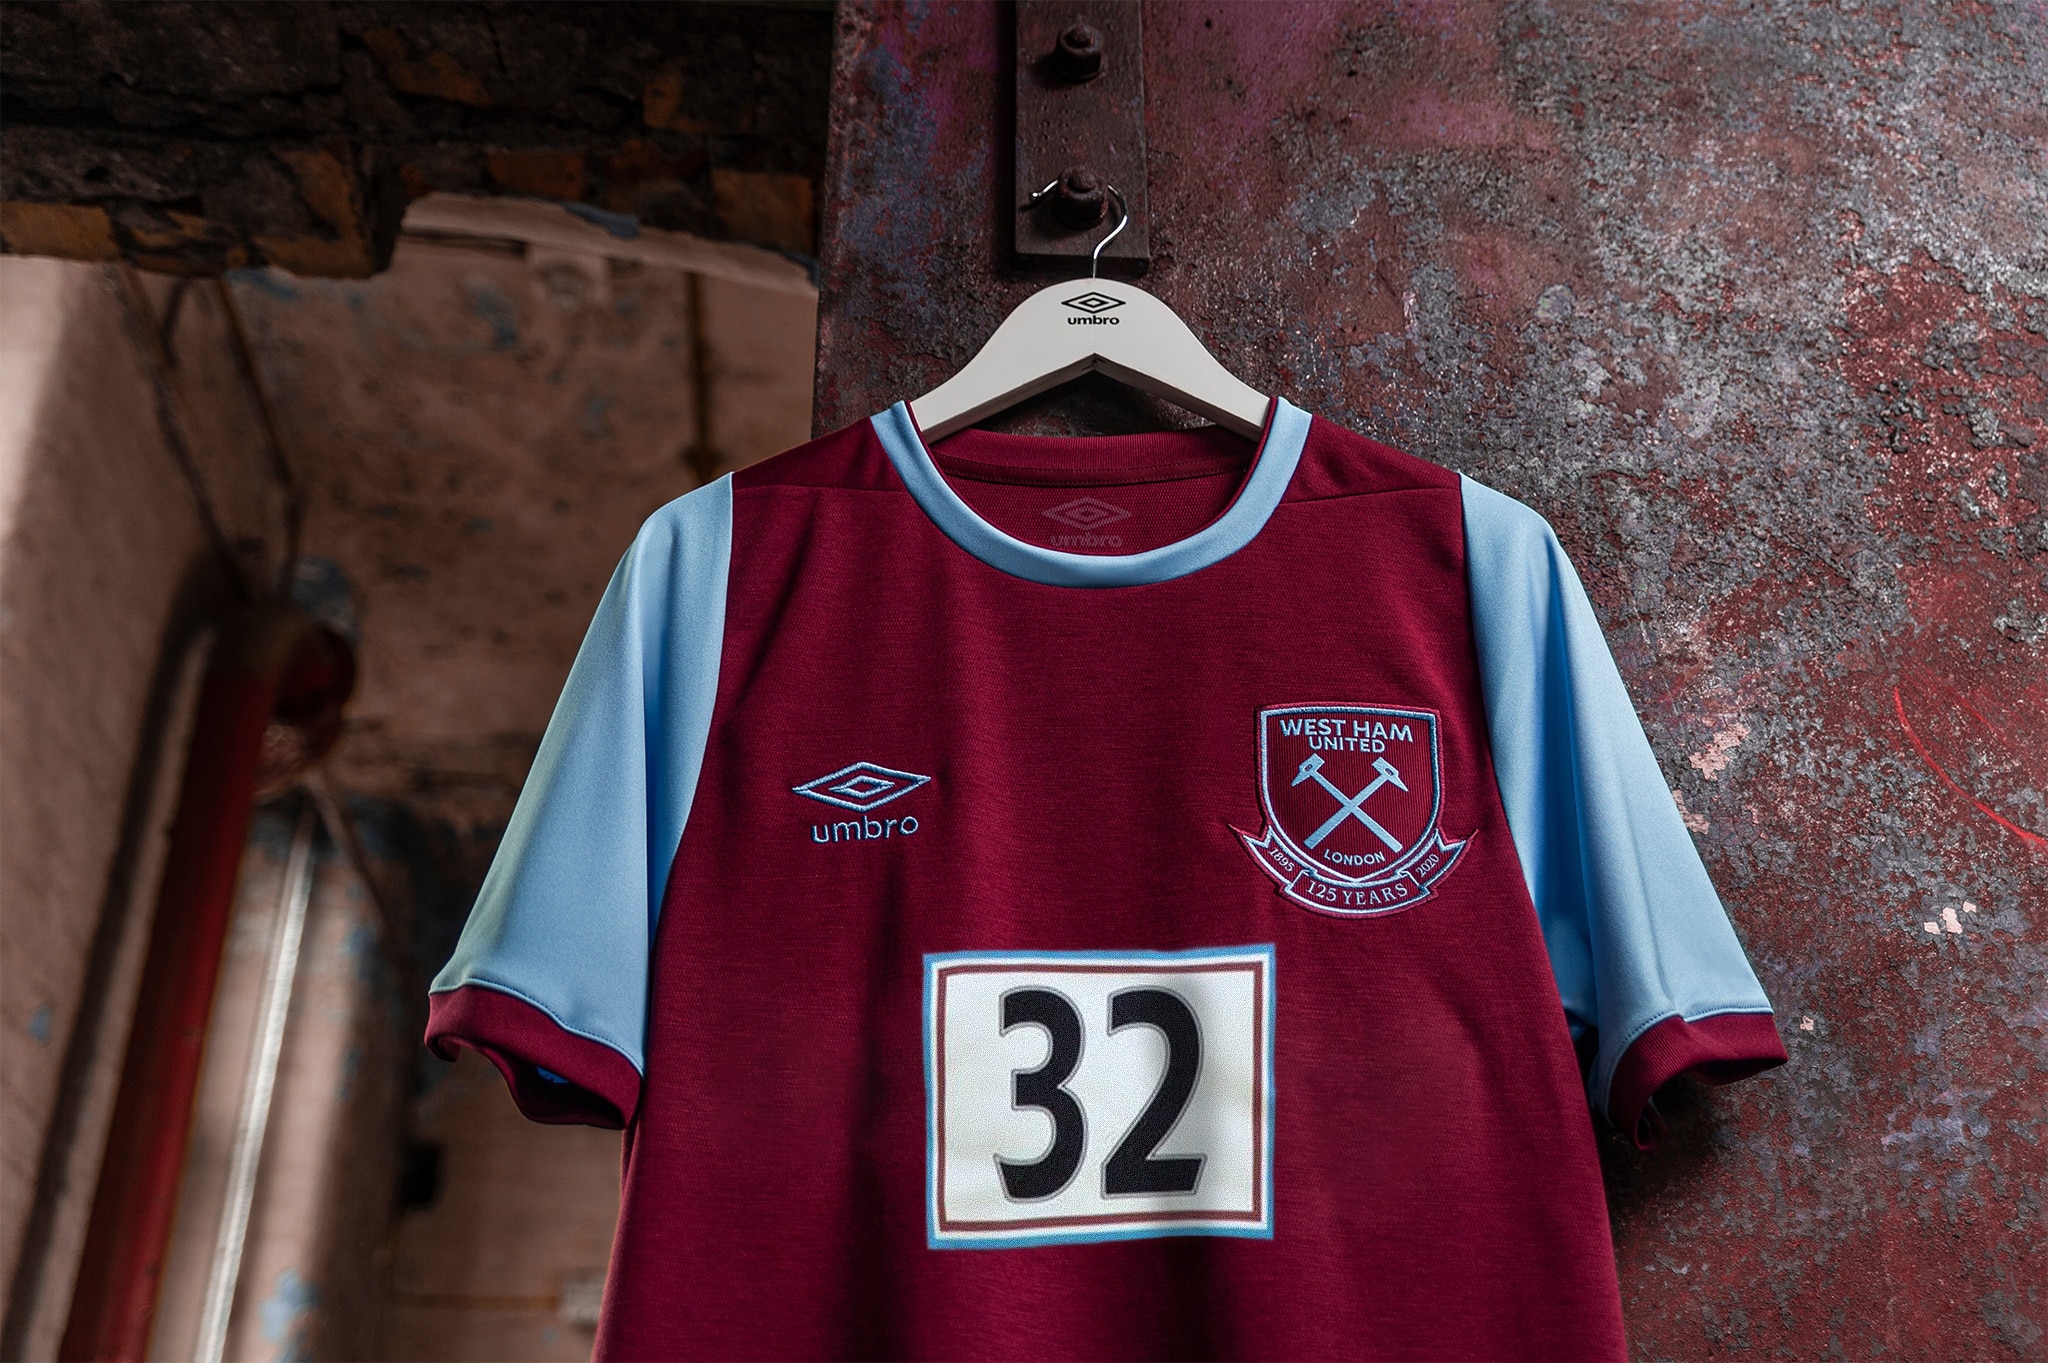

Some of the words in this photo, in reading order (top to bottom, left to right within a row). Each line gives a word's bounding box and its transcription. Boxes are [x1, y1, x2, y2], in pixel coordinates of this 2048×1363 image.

[1067, 315, 1120, 325] umbro
[1050, 532, 1122, 547] umbro
[1279, 718, 1347, 736] WEST
[1353, 720, 1414, 743] HAM
[1308, 736, 1386, 753] UNITED
[812, 815, 919, 843] umbro
[1268, 848, 1295, 873] 1895
[1323, 849, 1386, 867] LONDON
[1415, 853, 1440, 878] 2020
[1306, 880, 1337, 902] 125
[1342, 883, 1408, 906] YEARS
[993, 985, 1208, 1203] 32
